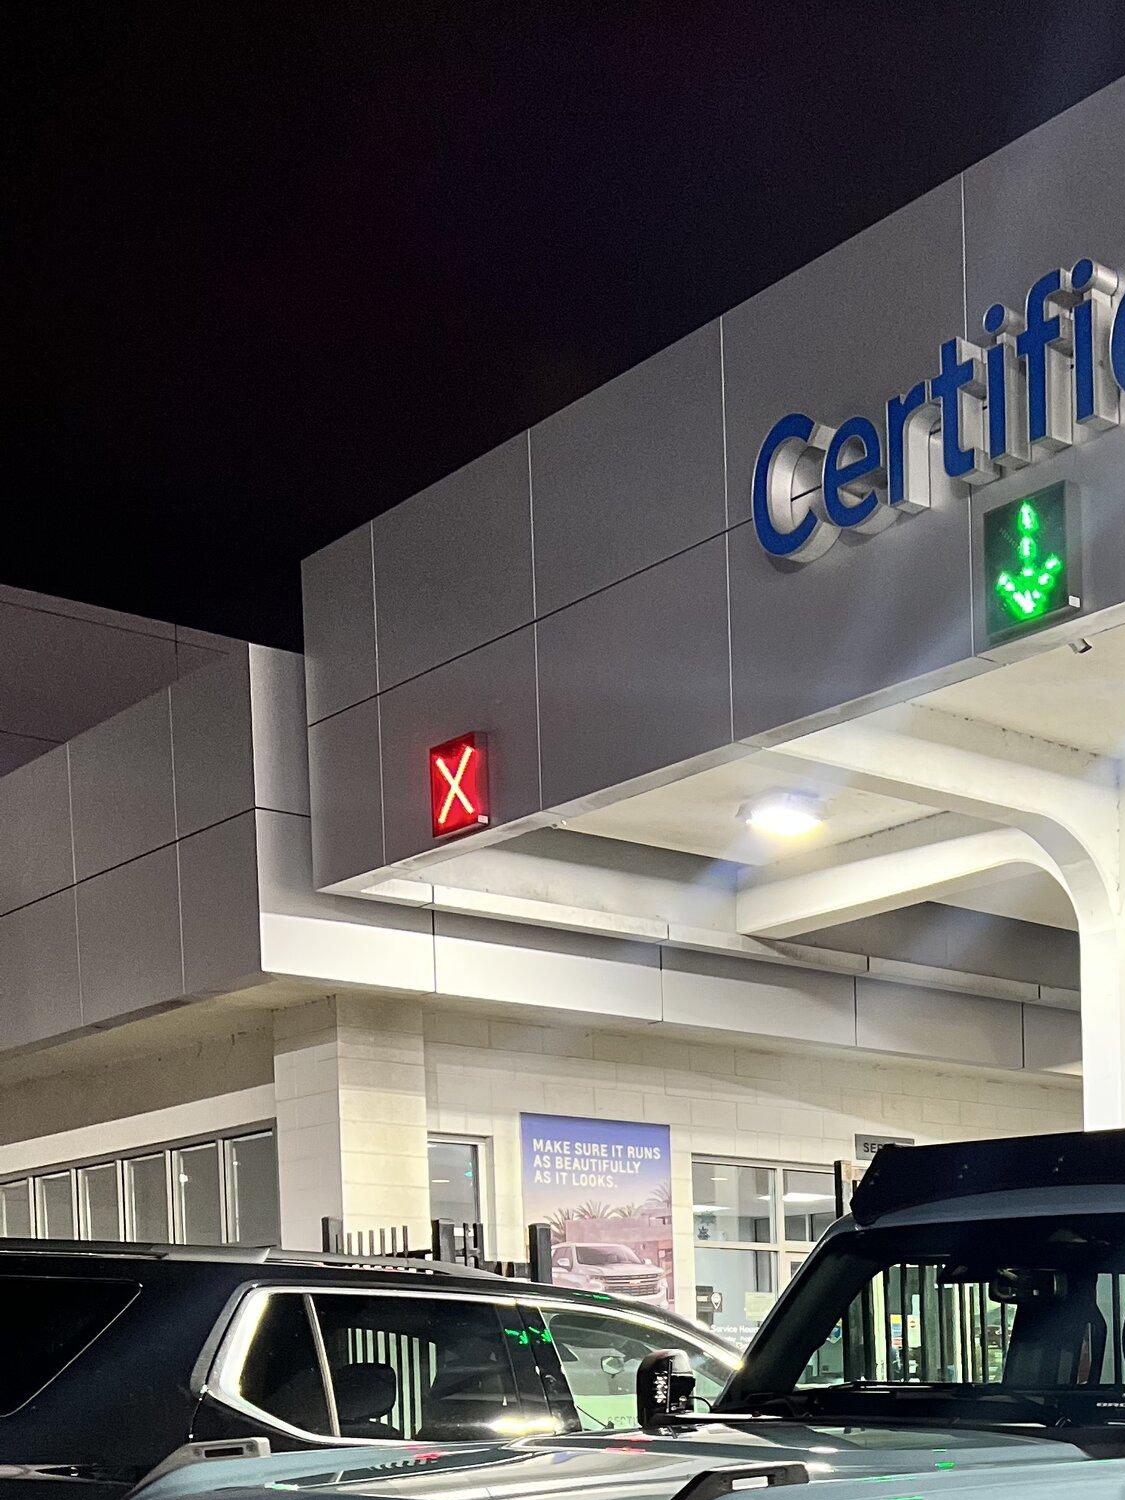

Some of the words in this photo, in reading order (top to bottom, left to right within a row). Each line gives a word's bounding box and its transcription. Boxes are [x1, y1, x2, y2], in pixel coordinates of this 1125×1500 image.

[533, 1138, 571, 1154] MAKE
[574, 1142, 608, 1158] SURE
[612, 1145, 623, 1158] IT
[627, 1146, 661, 1160] RUNS
[533, 1155, 551, 1168] AS
[555, 1156, 641, 1173] BEAUTIFULLY
[534, 1170, 551, 1183] AS
[555, 1172, 568, 1185] IT
[572, 1173, 618, 1188] LOOKS.
[740, 1325, 759, 1333] Hour
